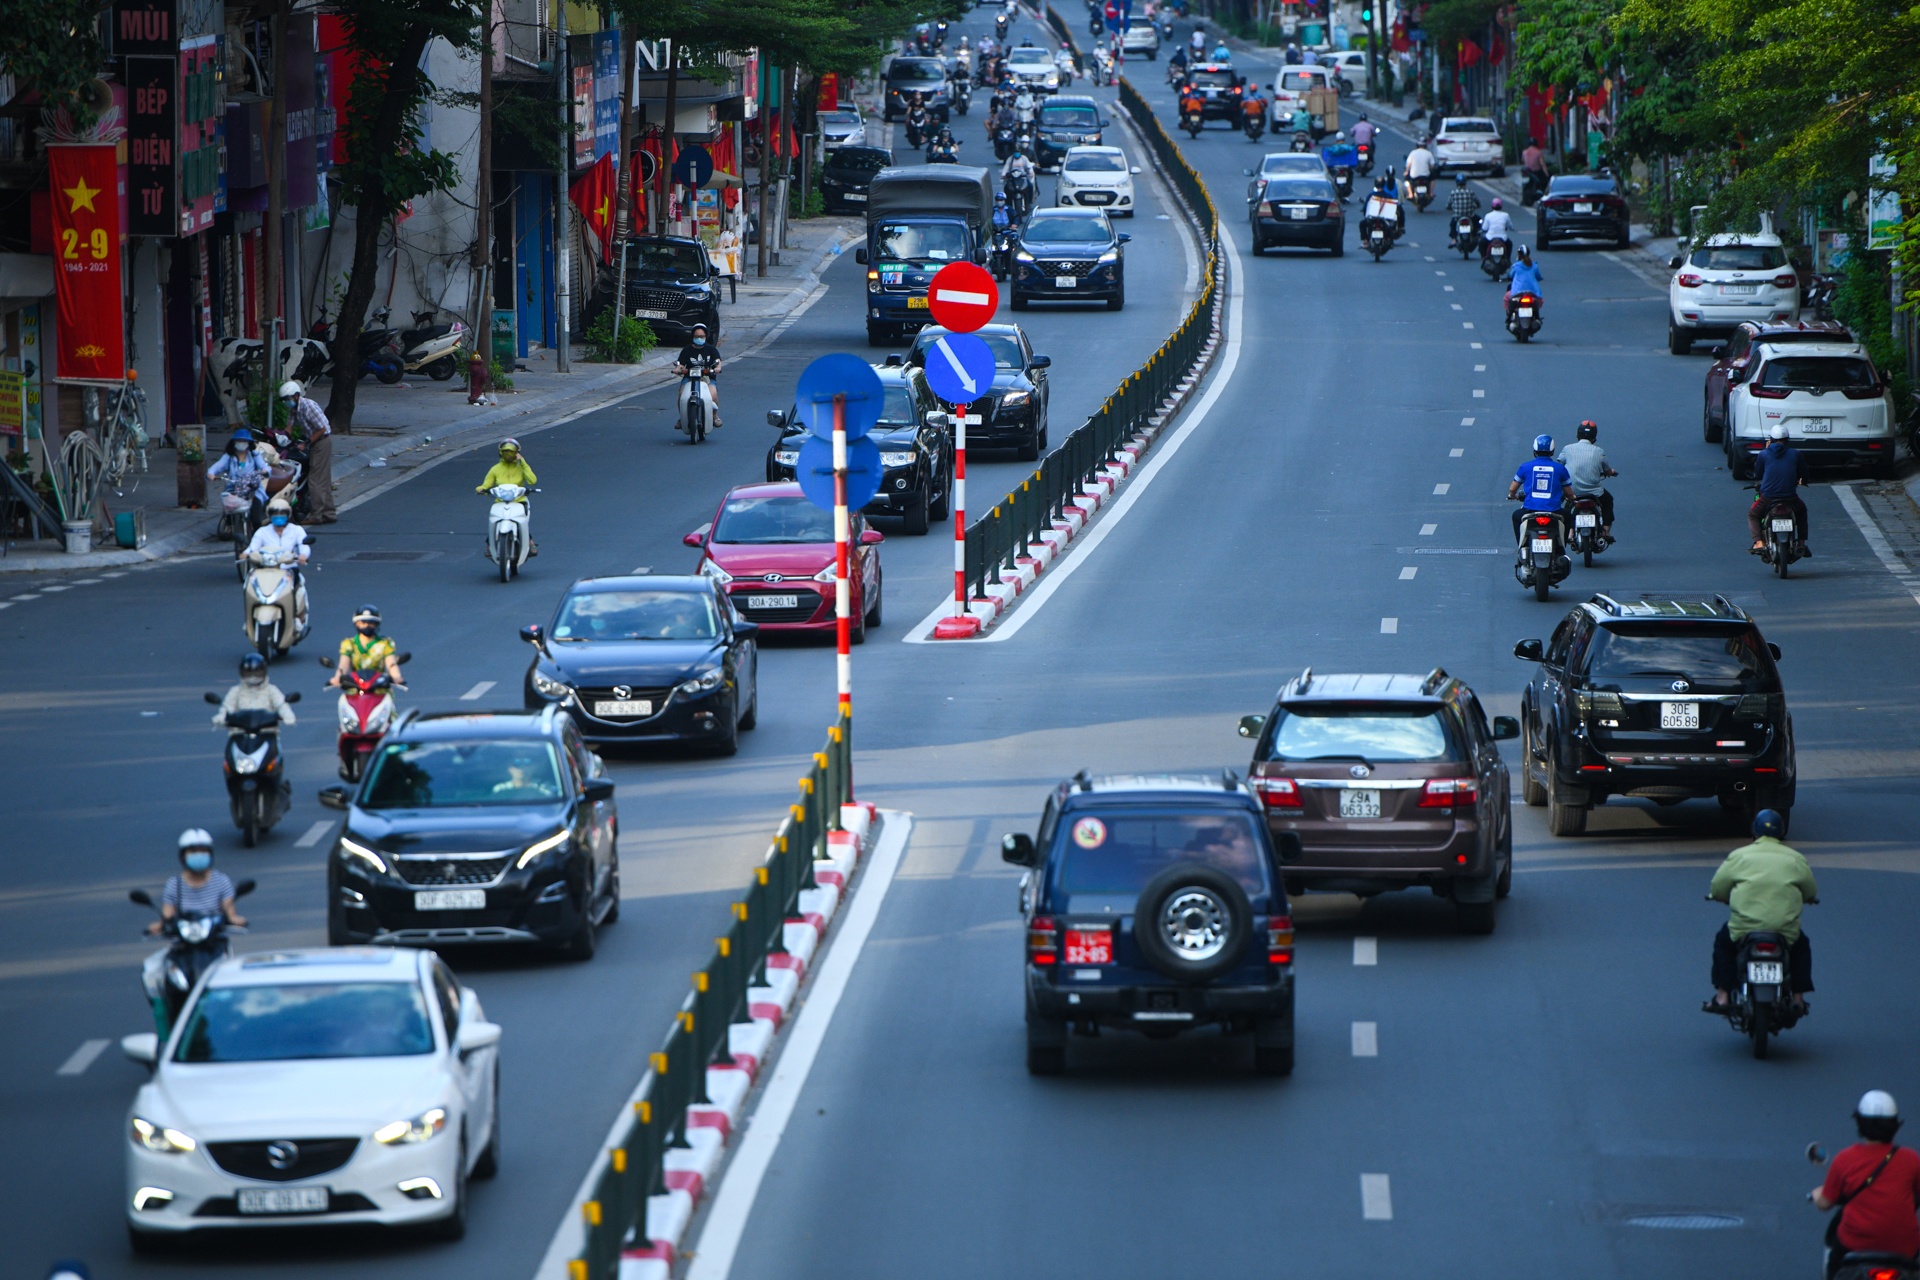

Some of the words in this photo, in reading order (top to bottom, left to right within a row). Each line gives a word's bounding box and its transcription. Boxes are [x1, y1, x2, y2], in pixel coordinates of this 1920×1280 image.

[120, 4, 169, 41] MÙI
[136, 78, 167, 115] BẾP
[133, 132, 171, 171] ĐIỆN
[141, 181, 165, 215] TỪ
[62, 228, 109, 259] 2-9
[64, 263, 84, 272] 1945
[89, 262, 109, 272] 2021
[749, 597, 796, 608] 30A-290.14
[1670, 703, 1691, 715] 30E
[1662, 716, 1698, 727] 605.89
[1350, 791, 1371, 803] 29A
